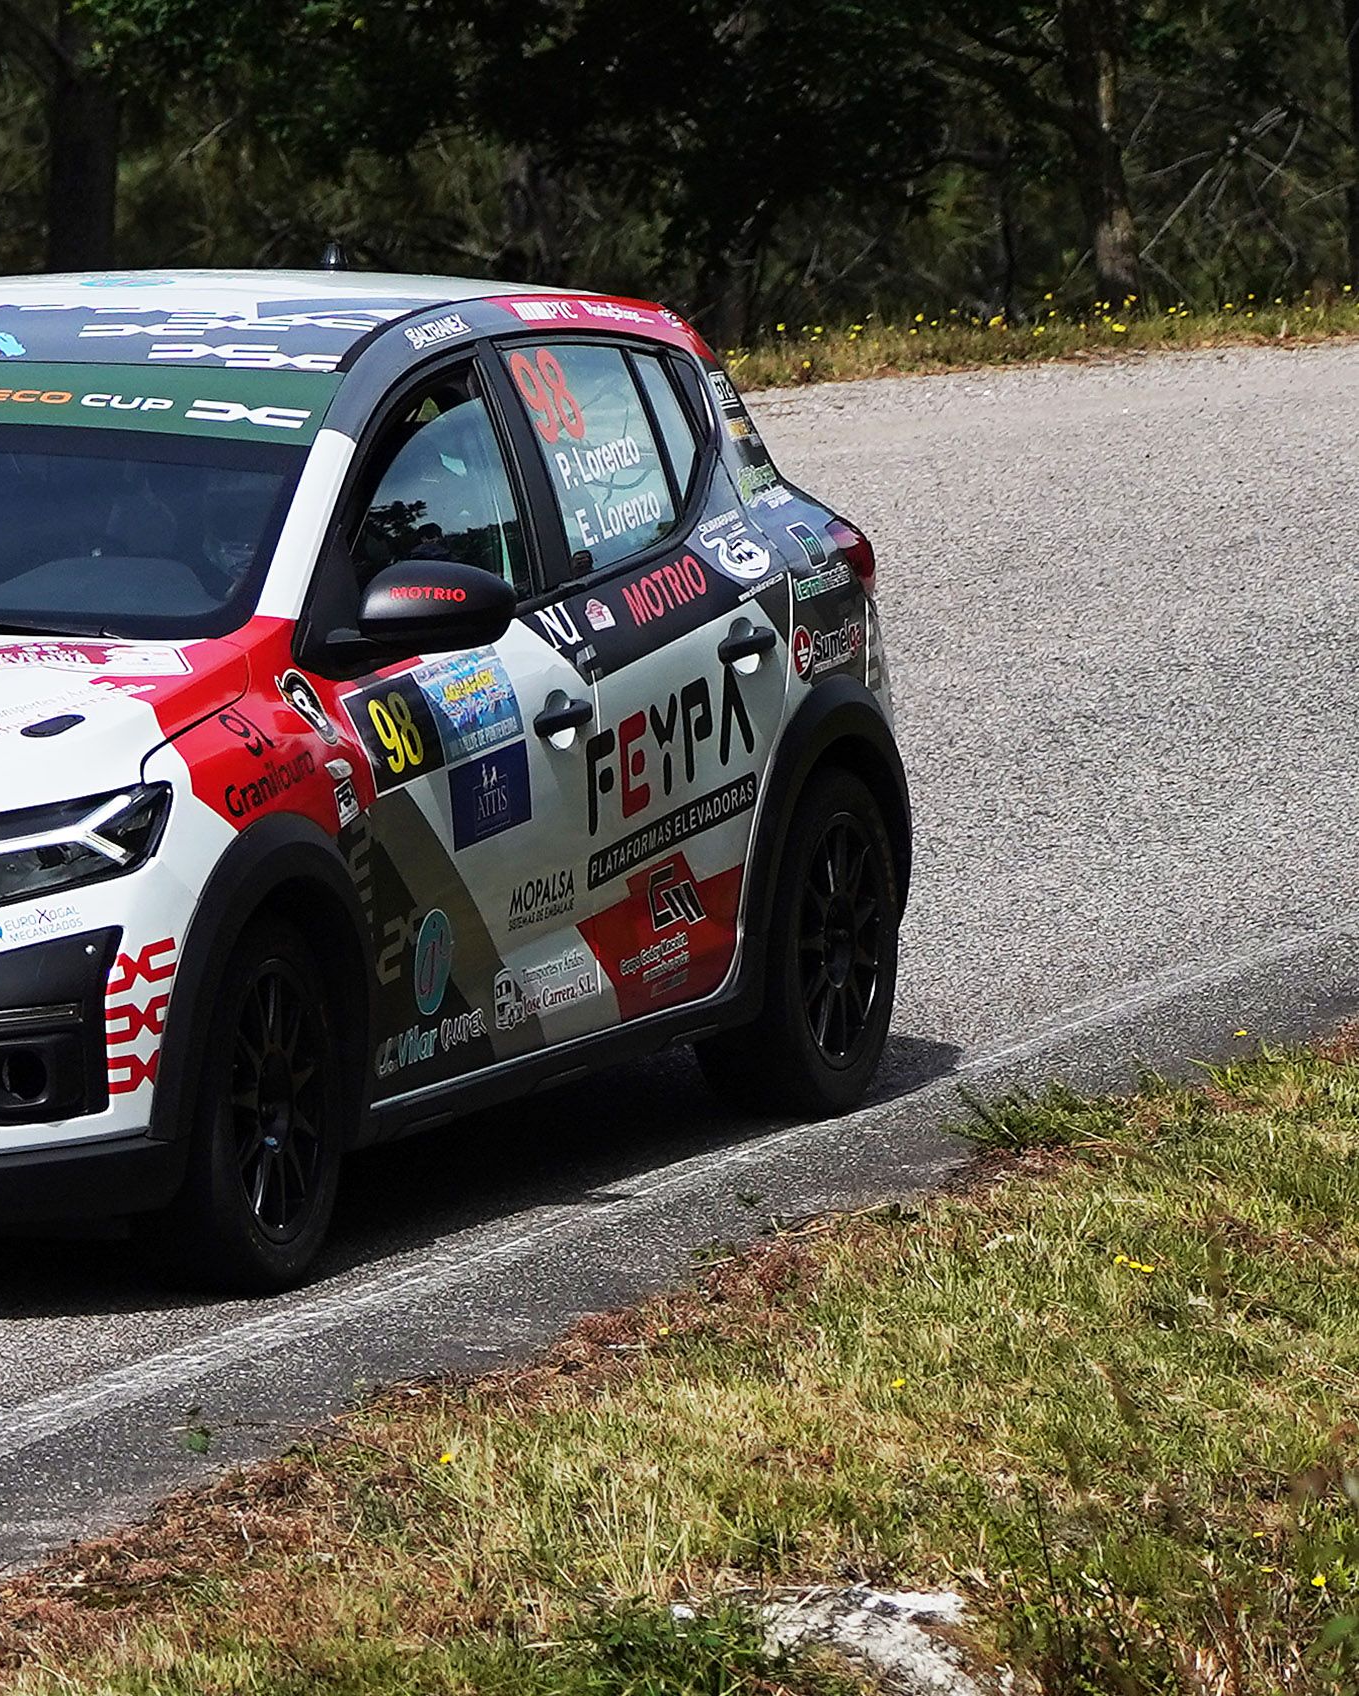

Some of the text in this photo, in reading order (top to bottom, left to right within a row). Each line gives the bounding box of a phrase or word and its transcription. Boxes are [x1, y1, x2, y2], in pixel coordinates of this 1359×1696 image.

[80, 393, 174, 412] CUP
[509, 348, 586, 443] 98
[554, 435, 641, 490] P. Lorenzo
[575, 508, 600, 548] E.
[594, 490, 662, 540] Lorenzo
[389, 586, 467, 603] MOTRIO
[621, 554, 708, 627] MOTRIO
[367, 690, 424, 775] 98
[585, 662, 756, 837] FEYPA
[477, 785, 509, 821] ATTIS
[591, 779, 755, 879] PLATAFORMAS ELEVADORAS
[509, 869, 575, 917] MOPALSA
